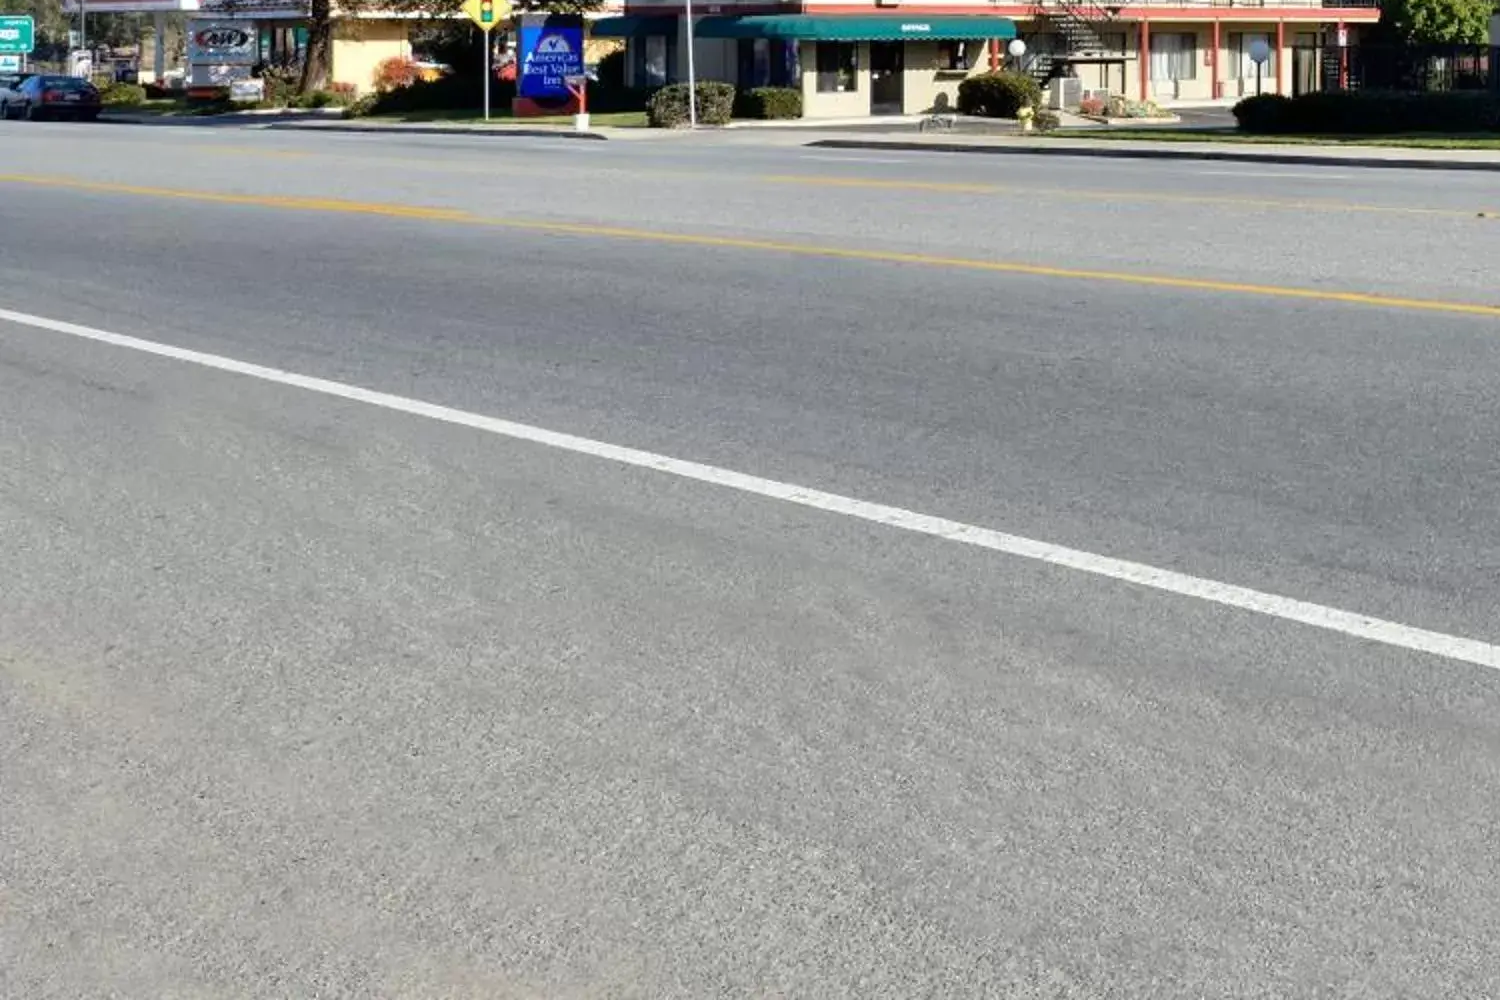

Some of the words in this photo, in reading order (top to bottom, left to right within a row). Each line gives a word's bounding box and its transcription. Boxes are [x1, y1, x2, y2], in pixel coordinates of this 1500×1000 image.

[523, 63, 548, 74] Best
[551, 63, 579, 74] Value
[543, 75, 562, 85] Inn
